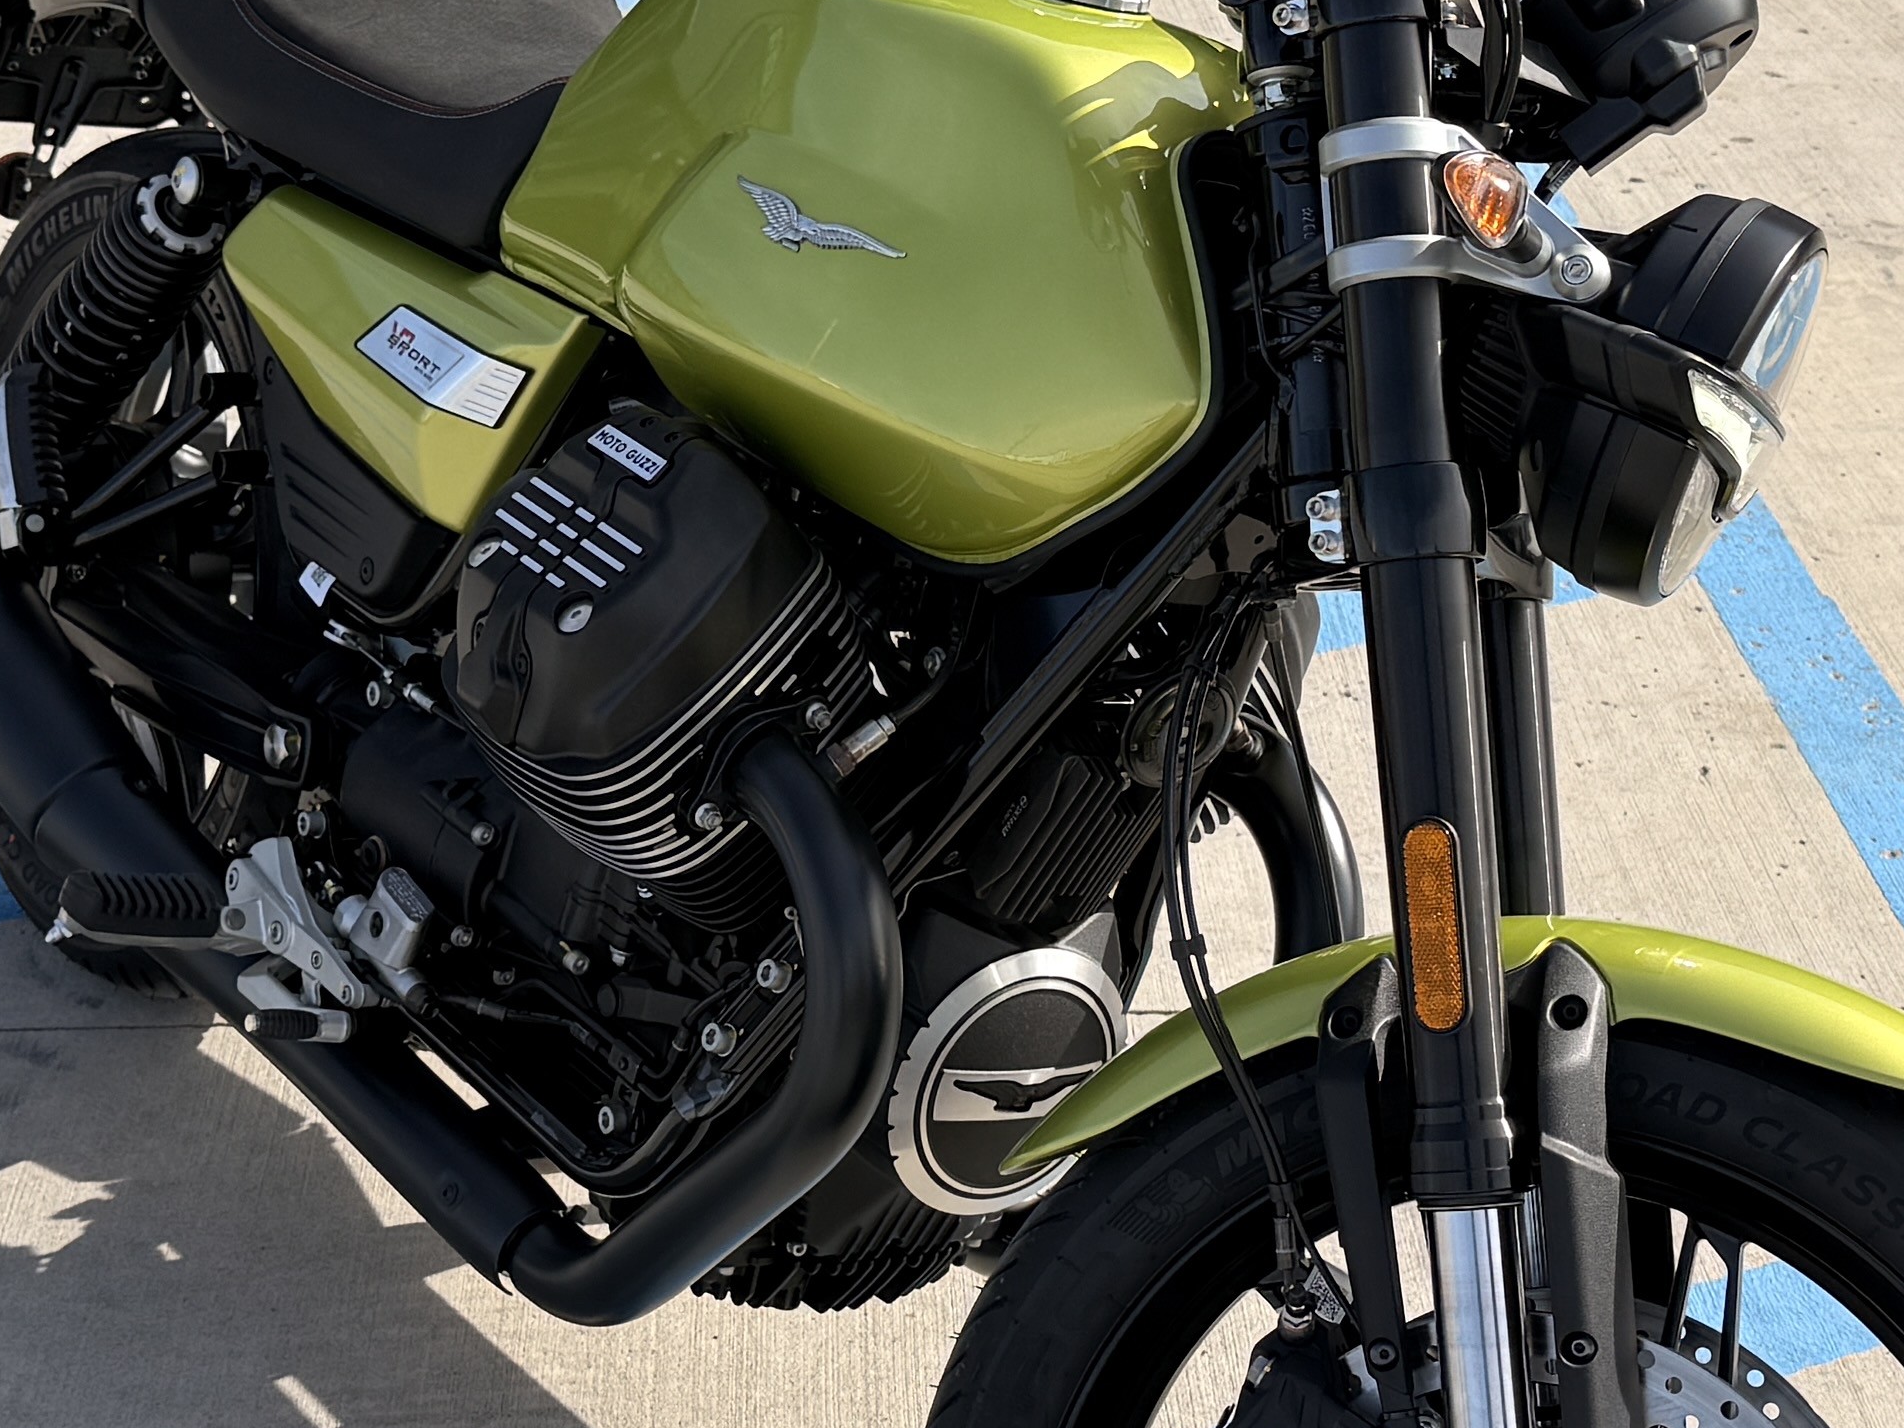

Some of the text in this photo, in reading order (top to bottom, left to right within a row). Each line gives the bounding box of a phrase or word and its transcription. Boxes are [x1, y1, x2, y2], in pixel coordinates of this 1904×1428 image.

[7, 193, 109, 293] MICHELIN
[387, 333, 442, 374] SPORT
[595, 429, 661, 475] MOTO GUZZI
[1611, 1070, 1727, 1127] OAD
